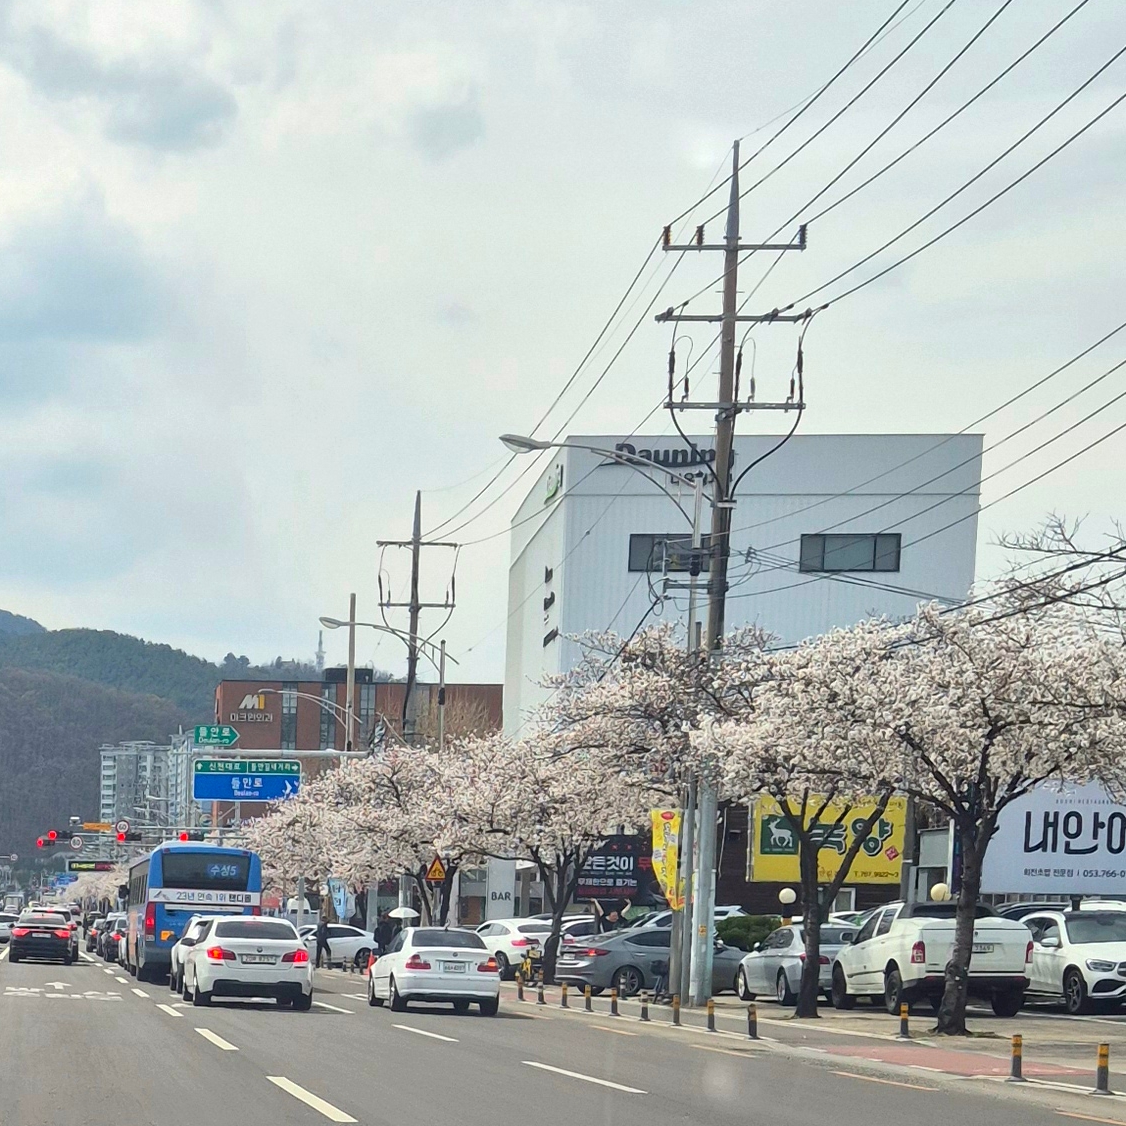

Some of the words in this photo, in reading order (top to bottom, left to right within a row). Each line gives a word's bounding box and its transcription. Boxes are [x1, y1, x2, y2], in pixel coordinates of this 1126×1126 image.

[615, 443, 735, 468] Daunin
[232, 777, 263, 789] 들안로
[210, 865, 237, 877] 수성5
[491, 891, 511, 901] BAR
